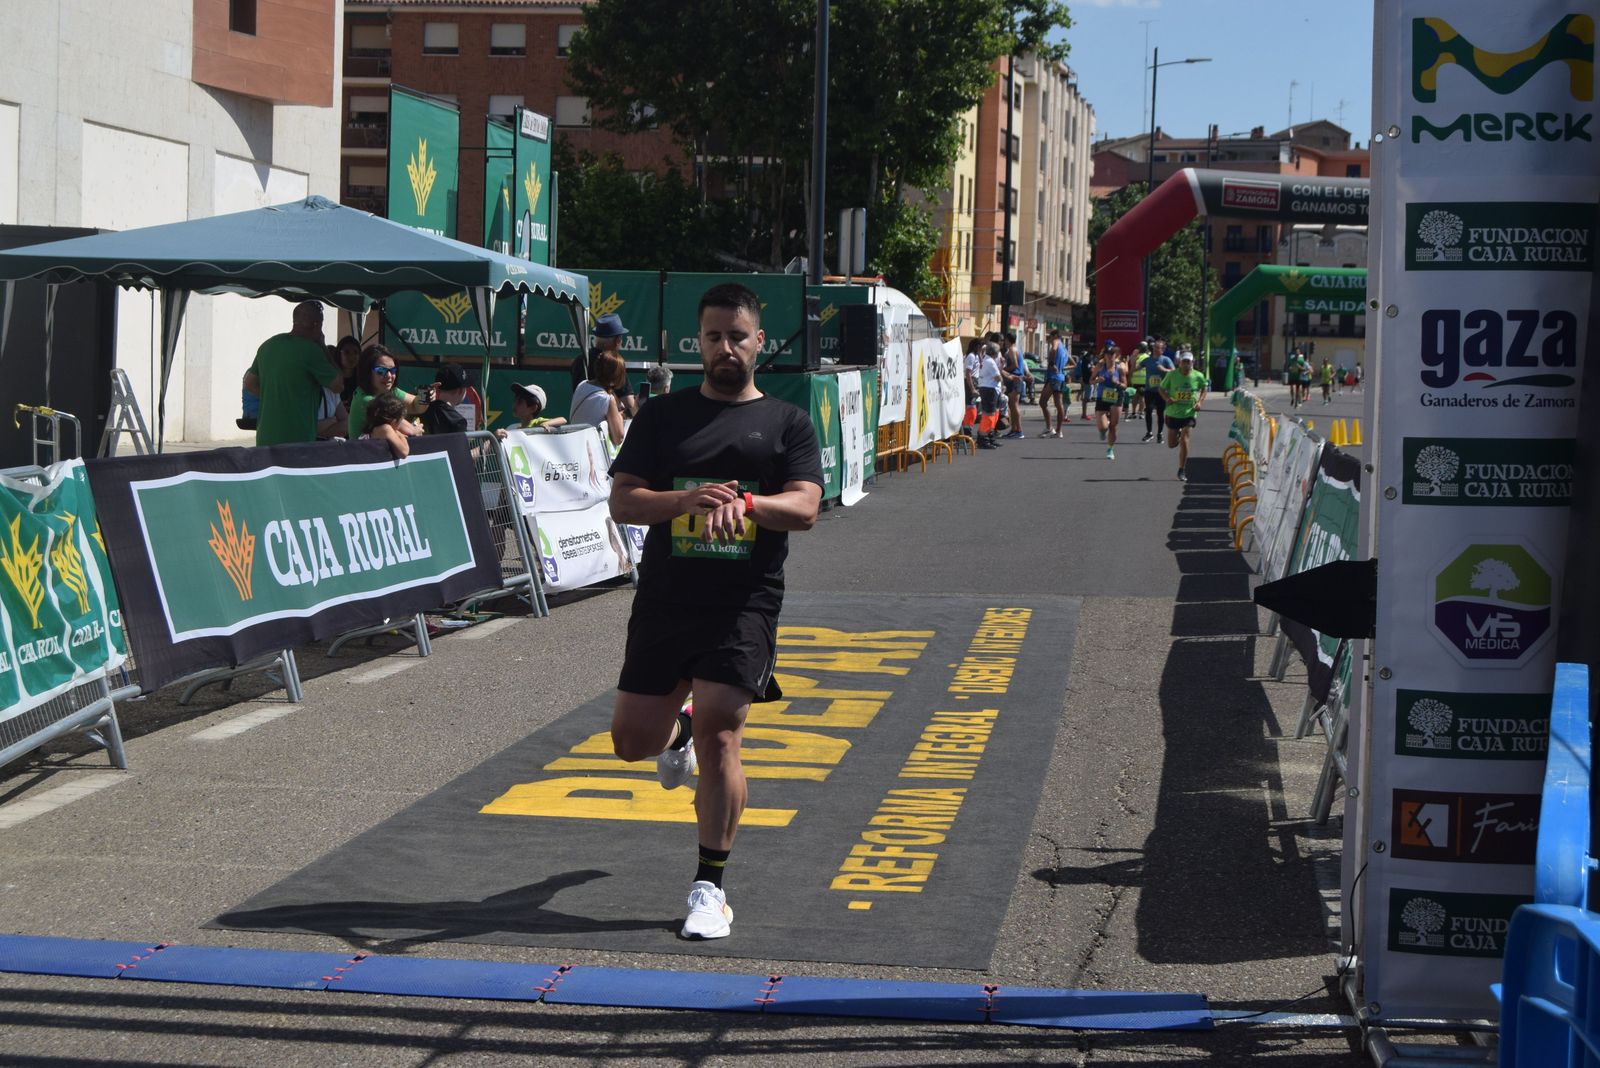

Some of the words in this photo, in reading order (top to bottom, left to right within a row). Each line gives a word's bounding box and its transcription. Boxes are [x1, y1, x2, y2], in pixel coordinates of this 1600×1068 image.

[1236, 194, 1276, 206] ZAMORA
[1292, 184, 1321, 197] CON
[1324, 186, 1341, 198] EL
[1291, 200, 1357, 215] GANAMOS
[1468, 227, 1589, 246] FUNDACION
[1468, 246, 1519, 264] CAJA
[1523, 246, 1587, 263] RURAL
[1310, 274, 1347, 289] CAJA
[1304, 299, 1367, 311] SALIDA
[398, 328, 441, 345] CAJA
[536, 332, 580, 350] CAJA
[1420, 309, 1578, 389] gaza
[1420, 392, 1499, 409] Ganaderos
[1502, 392, 1521, 408] de
[1524, 393, 1576, 409] Zamora
[1464, 481, 1514, 499] CAJA
[264, 516, 345, 588] CAJA
[338, 503, 432, 574] RURAL
[693, 542, 717, 552] CAJA
[718, 544, 749, 554] RURAL
[967, 607, 1033, 654] INTERIORES
[947, 656, 1018, 694] DISEÑO
[898, 709, 1000, 780] INTEGRAL
[1457, 735, 1505, 752] CAJA
[829, 787, 969, 893] REFORMA
[1450, 916, 1509, 934] FUND
[1449, 933, 1499, 951] CAJA
